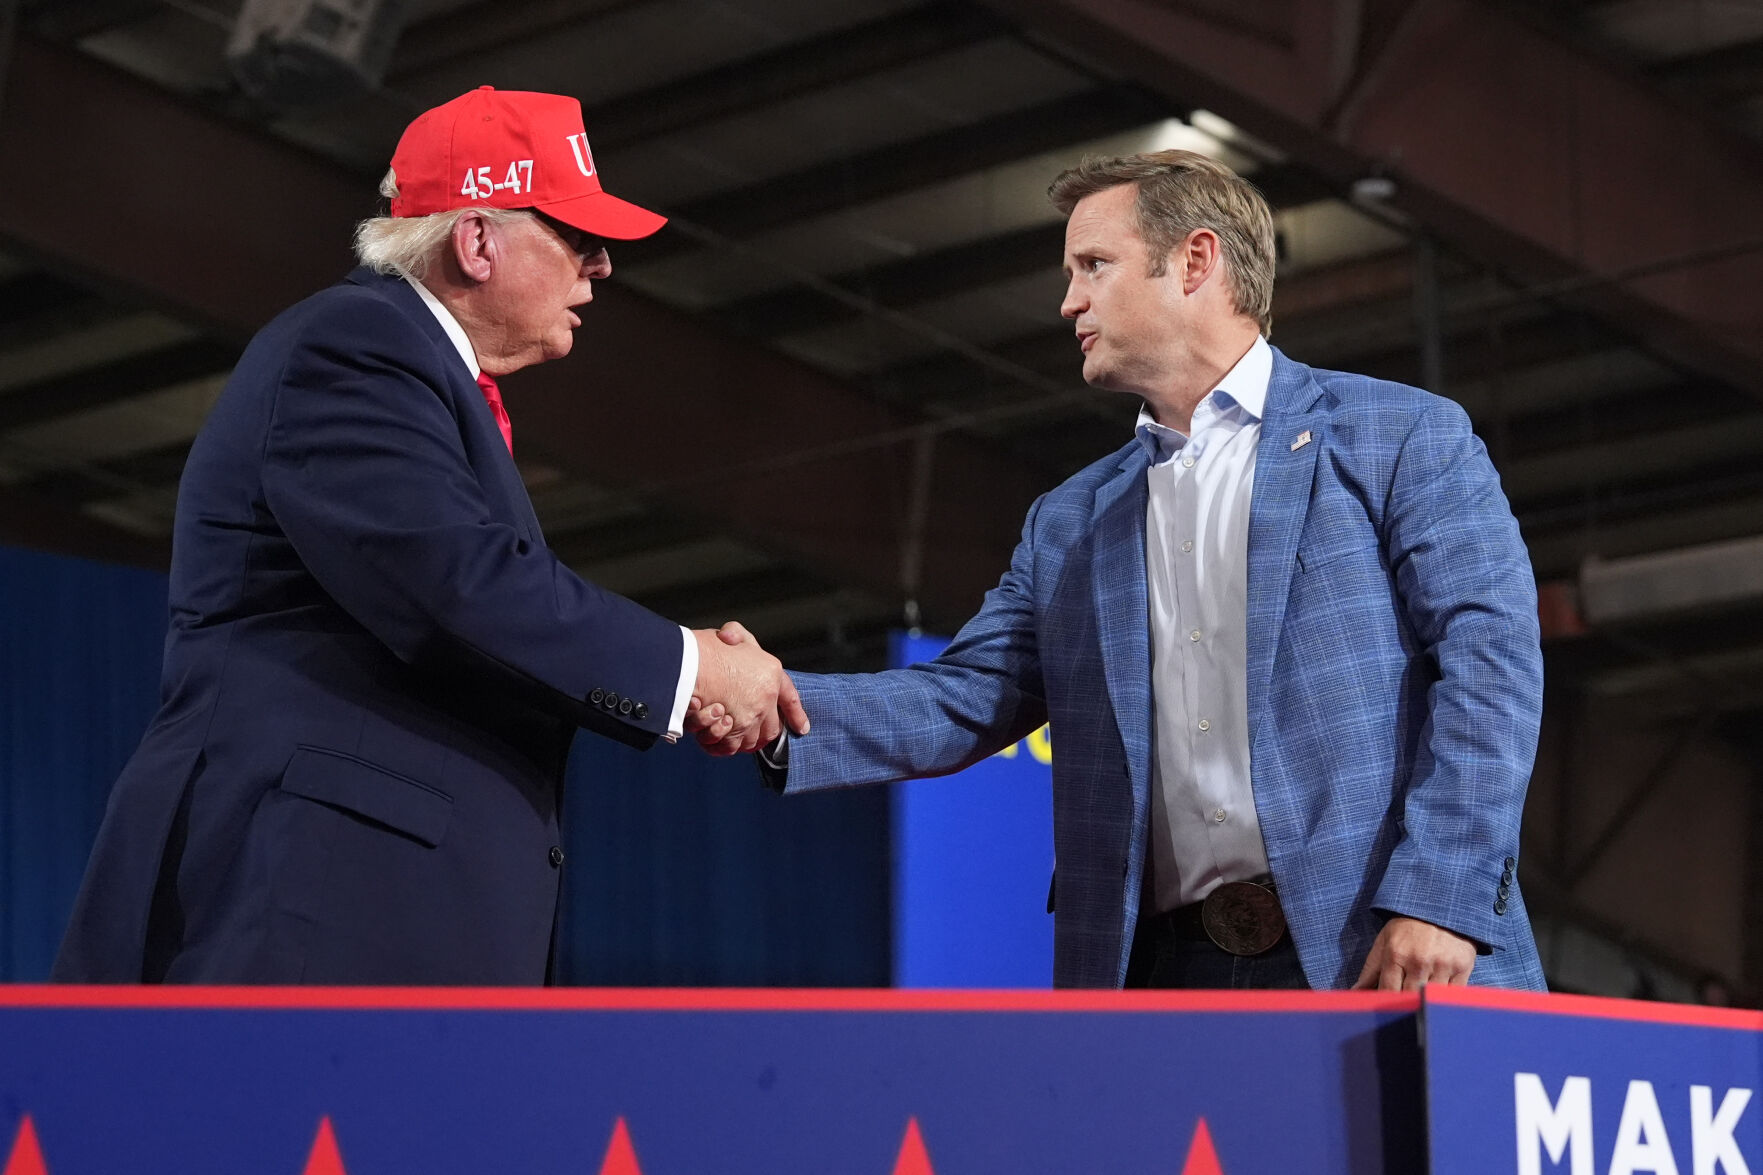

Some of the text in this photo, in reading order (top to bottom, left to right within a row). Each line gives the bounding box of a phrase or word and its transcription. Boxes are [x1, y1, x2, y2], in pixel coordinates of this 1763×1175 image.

[566, 132, 597, 177] U
[461, 160, 534, 199] 45-47
[1514, 1072, 1753, 1175] MAK
